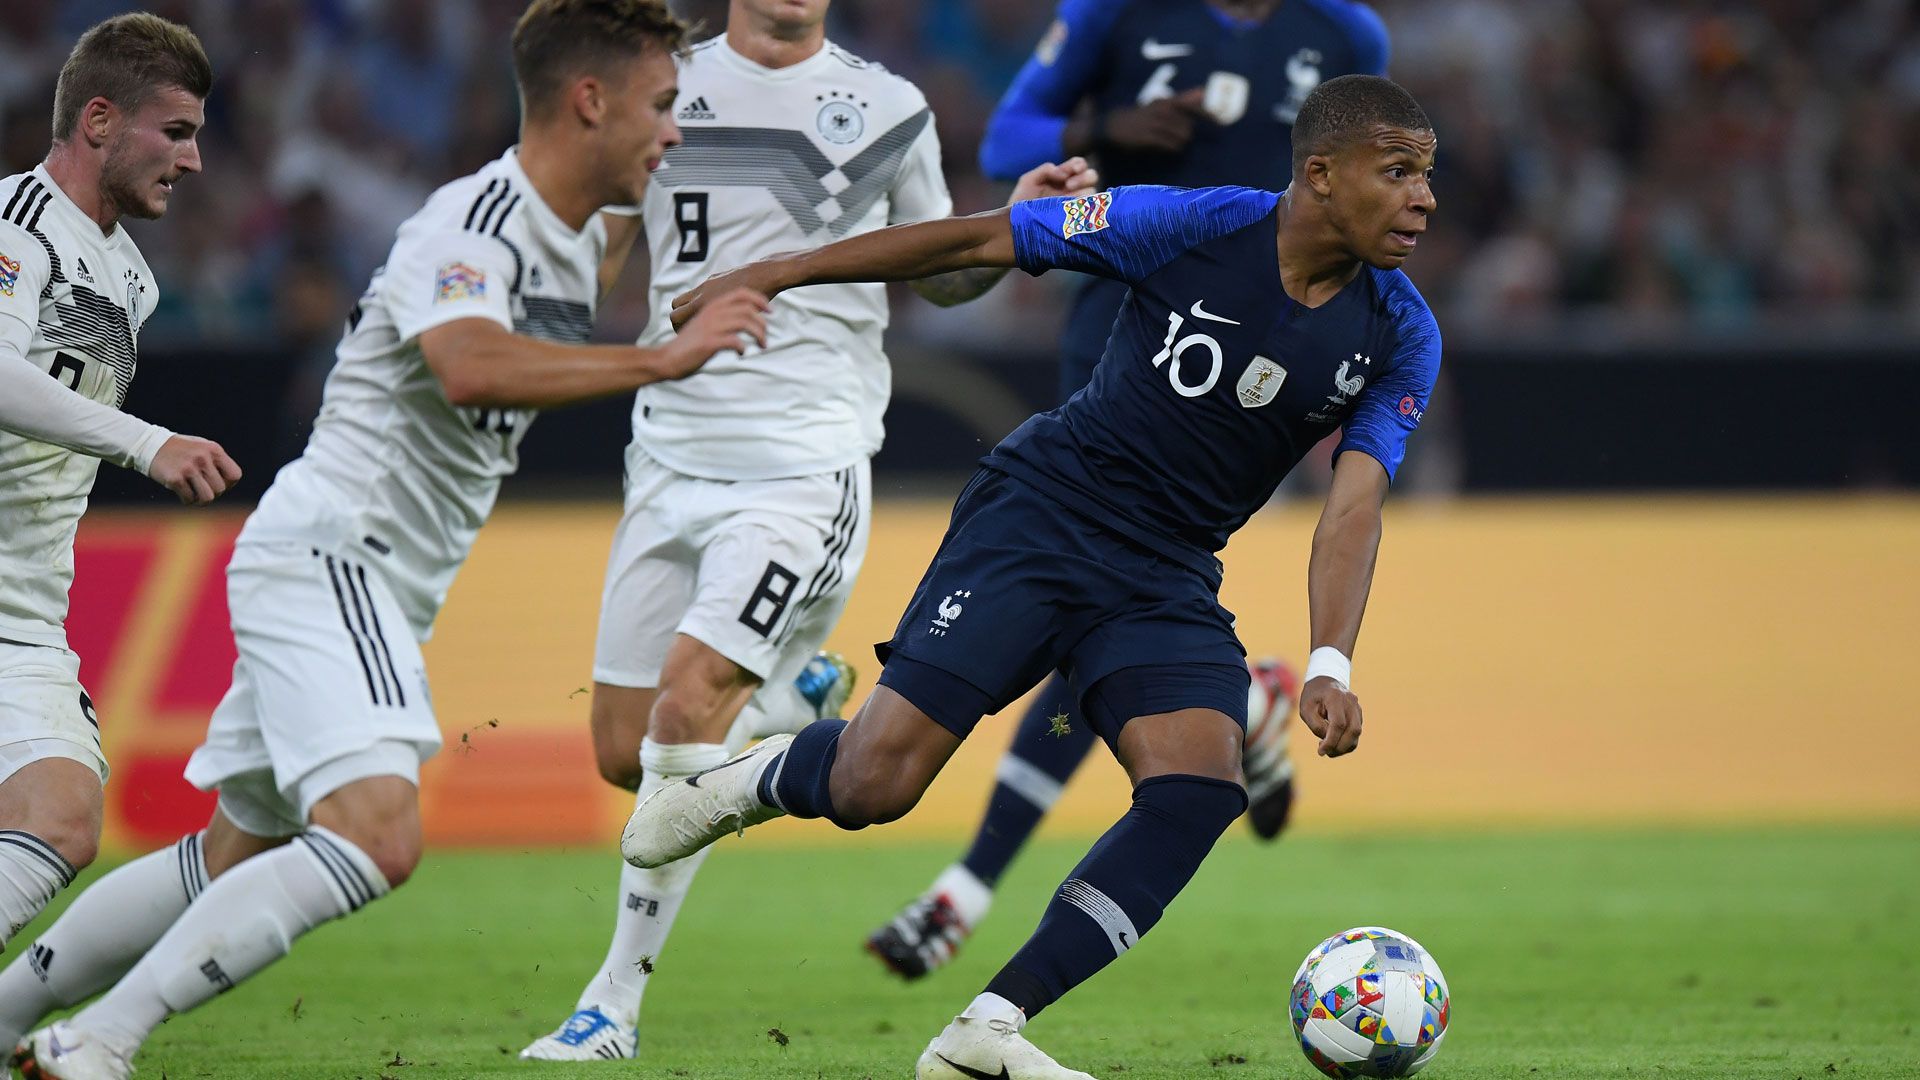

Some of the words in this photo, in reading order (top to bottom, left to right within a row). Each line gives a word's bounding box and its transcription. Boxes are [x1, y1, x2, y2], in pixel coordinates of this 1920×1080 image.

[673, 192, 709, 262] 8
[1152, 311, 1222, 397] 10
[1245, 388, 1262, 400] FIFA
[738, 560, 800, 638] 8
[627, 893, 659, 917] DFB
